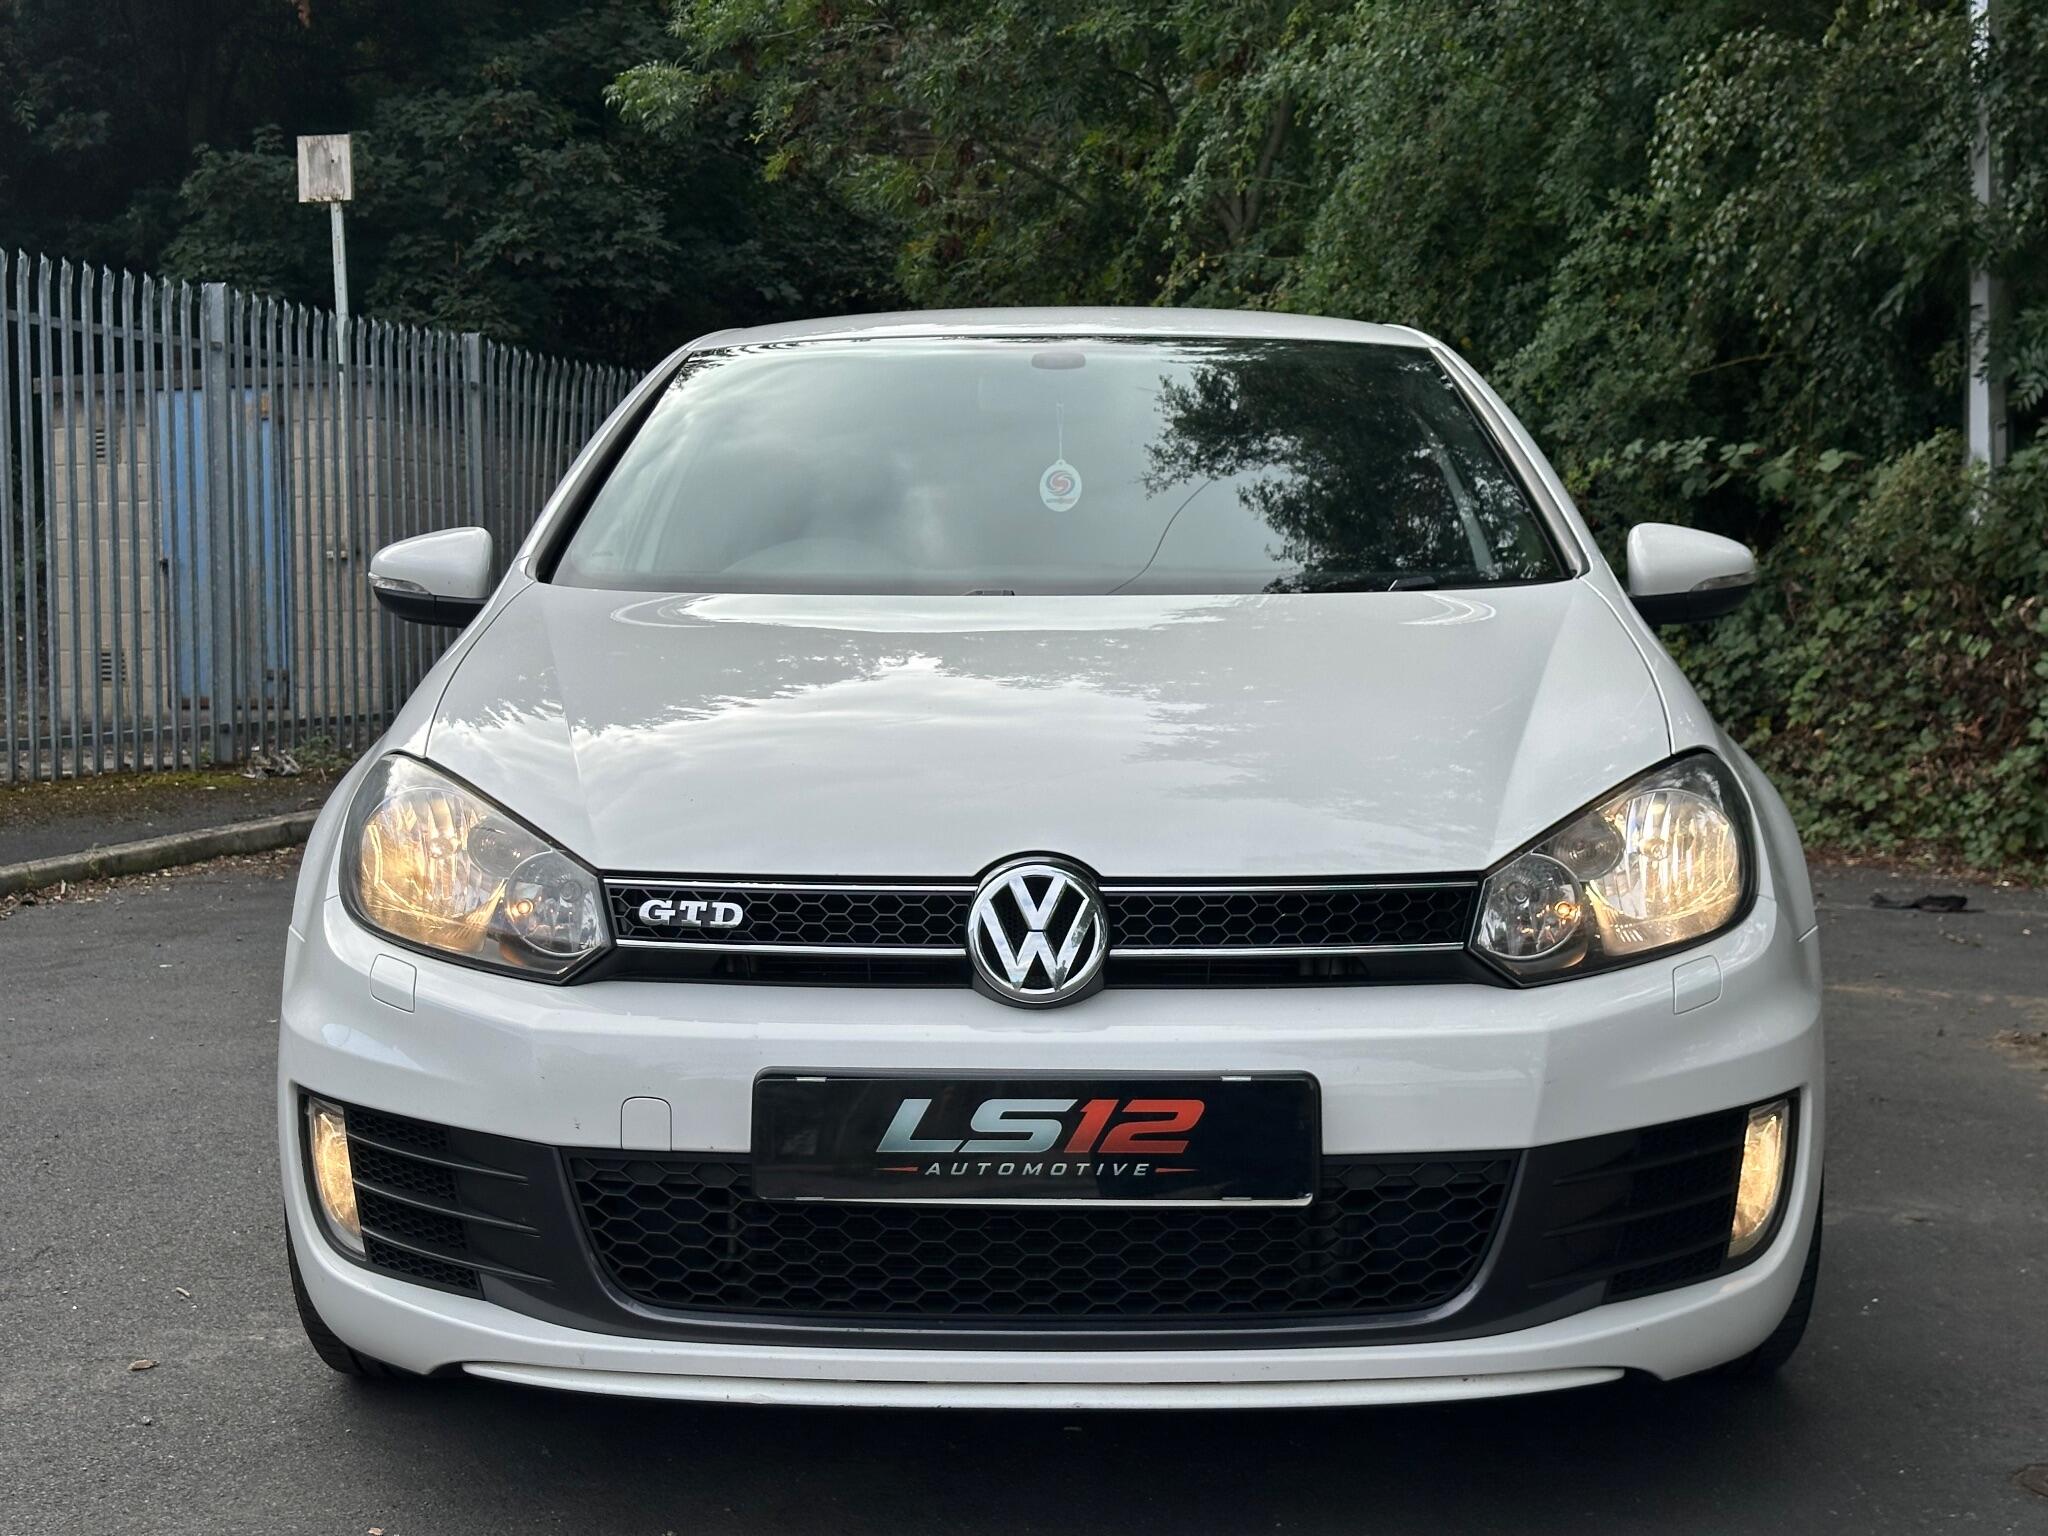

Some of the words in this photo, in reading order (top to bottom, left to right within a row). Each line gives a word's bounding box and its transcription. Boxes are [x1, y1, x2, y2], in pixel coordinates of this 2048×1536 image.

[639, 899, 743, 929] GTD
[977, 872, 1098, 993] VW
[876, 1098, 1205, 1153] LS12
[924, 1162, 1151, 1177] AUTOMOTIVE
